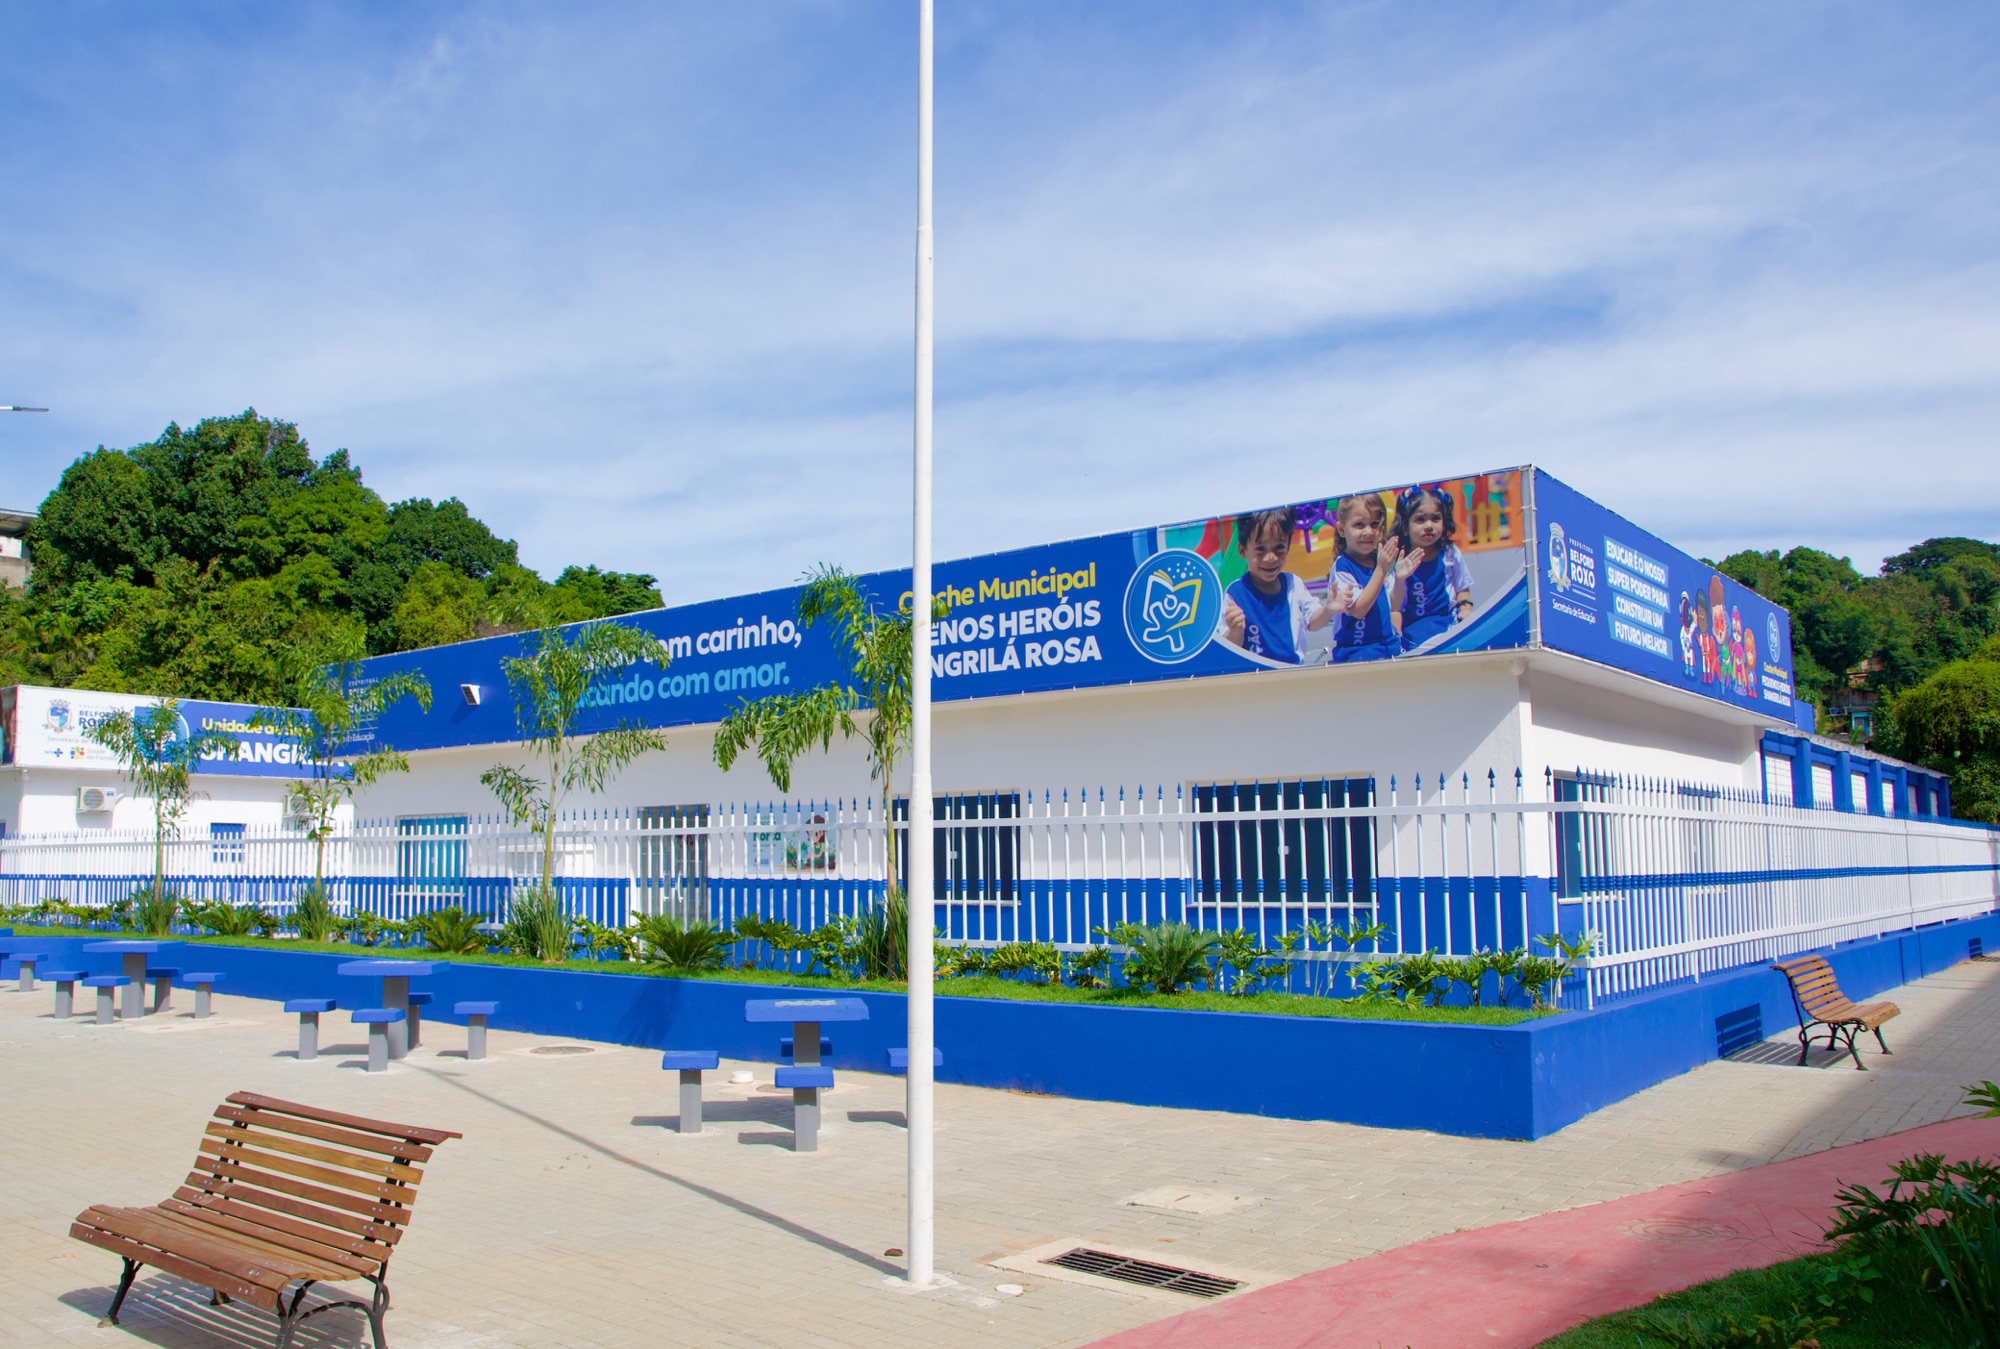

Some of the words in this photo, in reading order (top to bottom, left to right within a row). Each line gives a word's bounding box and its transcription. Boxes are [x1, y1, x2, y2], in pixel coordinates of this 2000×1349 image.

[1570, 548, 1595, 570] BELFORD
[1571, 562, 1596, 589] ROXO
[1606, 540, 1634, 569] EDUCAR
[1633, 550, 1639, 571] É
[1638, 557, 1644, 574] O
[1644, 560, 1666, 584] NOSSO
[898, 584, 975, 613] Cche
[979, 562, 1096, 603] Municipal
[1608, 566, 1630, 592] SUPER
[1630, 576, 1652, 602] PODER
[1652, 587, 1668, 609] PARA
[999, 596, 1102, 638] HERÓIS
[1552, 598, 1573, 615] Secretaria
[1578, 608, 1596, 625] Educação
[1615, 595, 1653, 626] CONSTRUIR
[1652, 611, 1663, 631] UM
[643, 634, 692, 663] om
[696, 615, 802, 655] carinho,
[1615, 620, 1641, 646] FUTURO
[1641, 631, 1668, 656] MELHOR
[930, 636, 1021, 680] NGRILÁ
[1025, 635, 1103, 668] ROSA
[658, 671, 710, 699] com
[714, 661, 790, 692] amor.
[200, 738, 345, 767] SHANGR
[753, 832, 781, 841] ora
